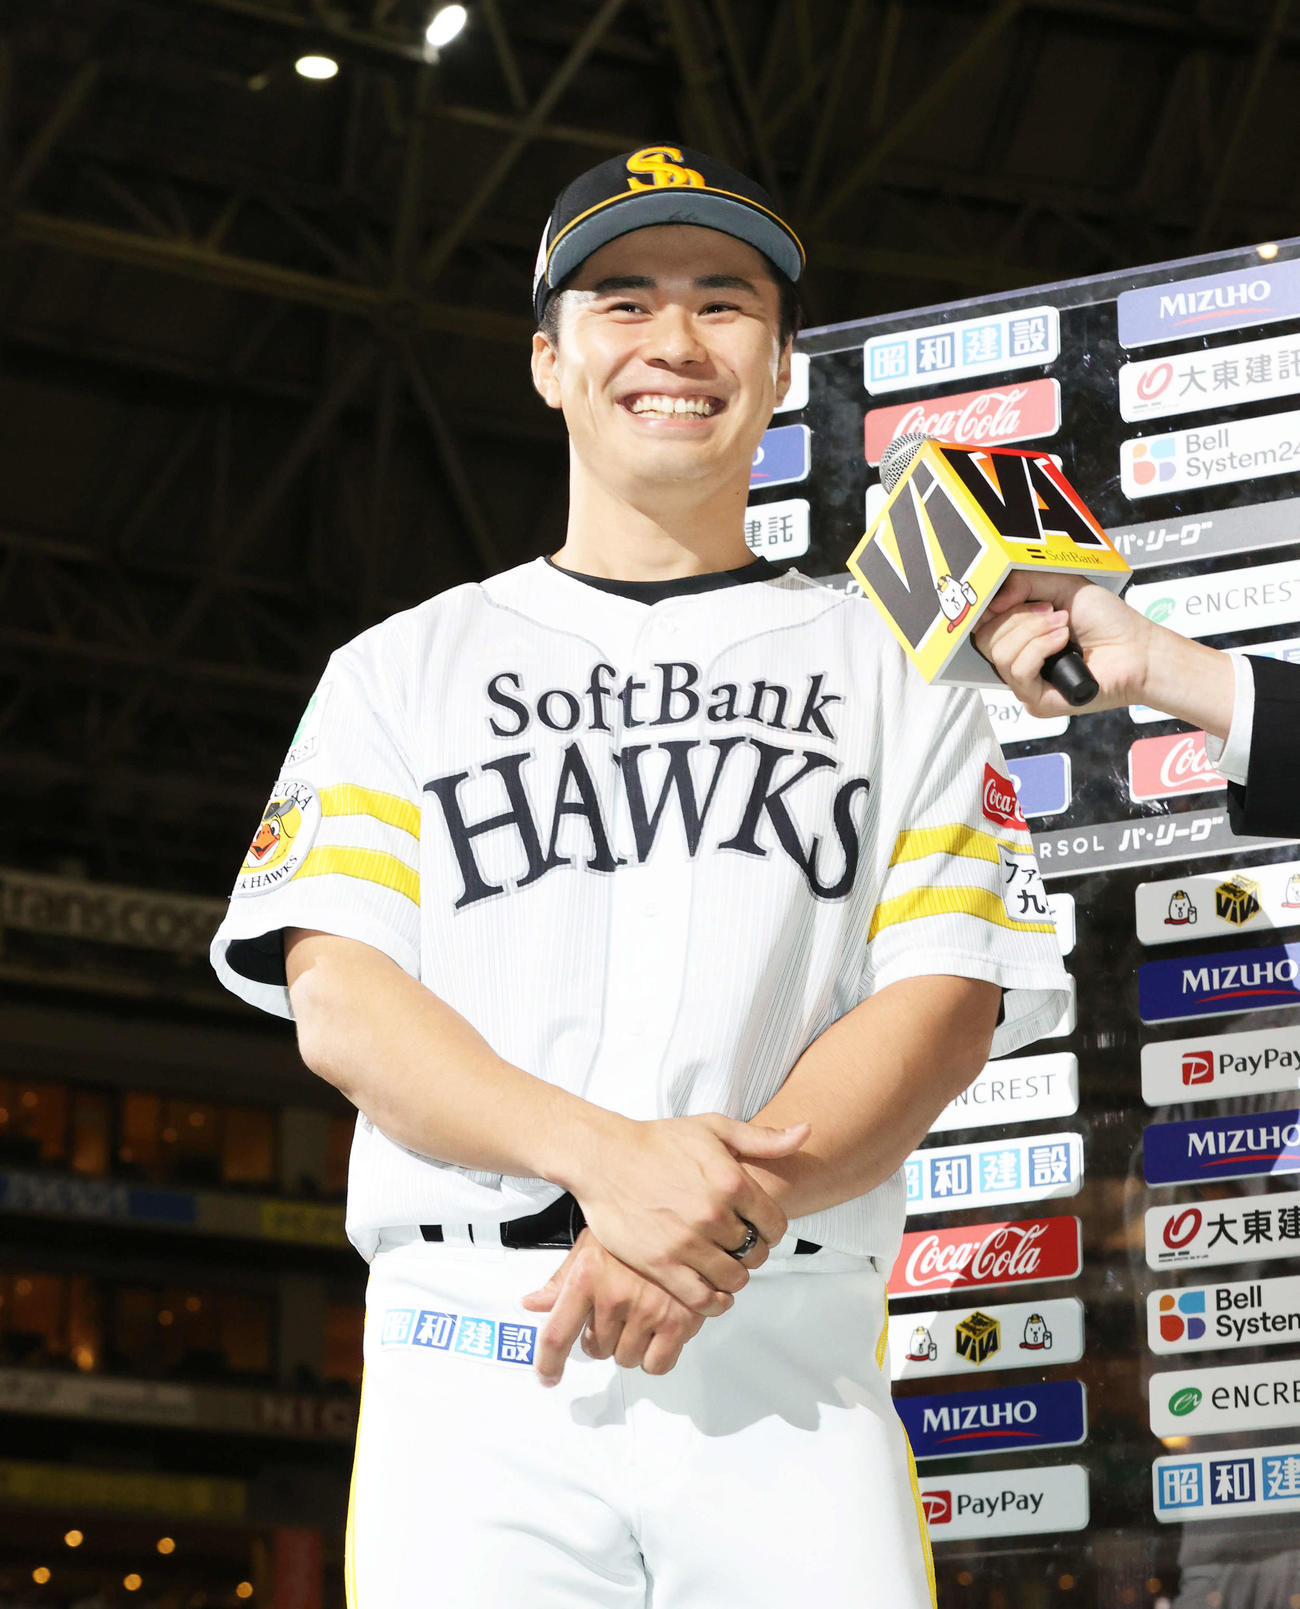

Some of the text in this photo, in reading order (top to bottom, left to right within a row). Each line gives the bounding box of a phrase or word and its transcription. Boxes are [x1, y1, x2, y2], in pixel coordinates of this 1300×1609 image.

[1160, 280, 1271, 319] MIZUHO
[871, 315, 1048, 382] 昭和建設
[1186, 428, 1229, 454] Bell
[1047, 549, 1103, 566] SoftBank
[486, 661, 845, 741] SoftBank
[423, 735, 870, 910] HAWKS
[1040, 836, 1104, 858] RSOL
[250, 854, 298, 889] HAWKS
[1005, 860, 1042, 884] ファ
[1182, 959, 1298, 994] MIZUHO
[955, 1074, 1056, 1107] NCREST
[1188, 1124, 1300, 1157] MIZUHO
[905, 1225, 1048, 1286] Coca-Cola
[1216, 1285, 1262, 1311] Bell
[381, 1309, 537, 1365] 昭和建設
[923, 1400, 1037, 1433] MIZUHO
[958, 1490, 1044, 1518] PayPay
